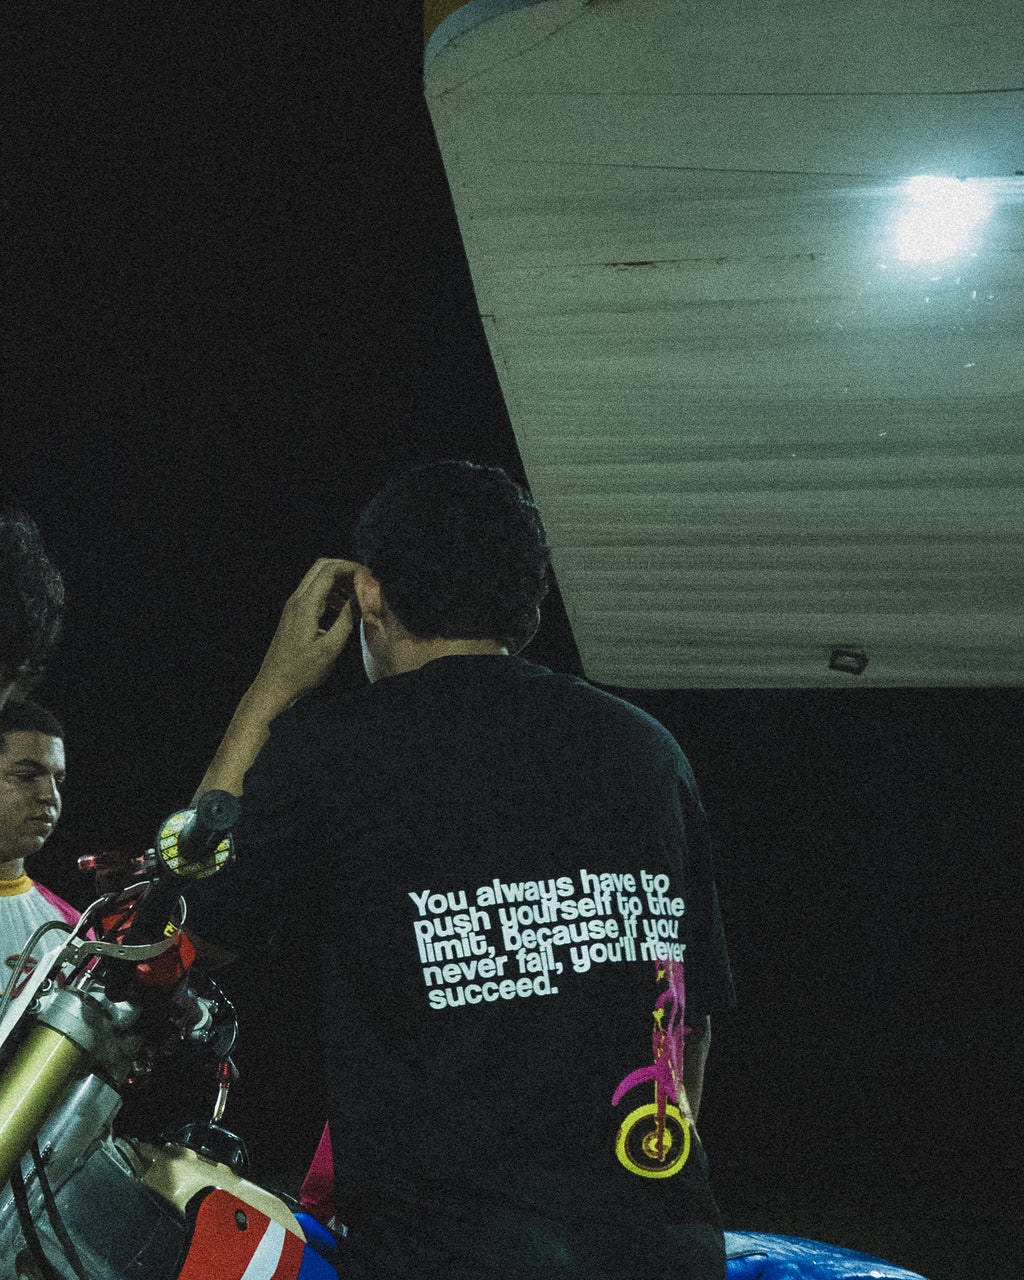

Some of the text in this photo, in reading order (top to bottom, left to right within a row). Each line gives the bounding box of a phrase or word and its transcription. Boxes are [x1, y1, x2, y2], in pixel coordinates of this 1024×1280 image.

[408, 869, 670, 916] You always have to
[413, 889, 685, 943] push yourself to the
[415, 914, 679, 964] limit, because if you
[422, 936, 686, 987] never fail, you'll never
[428, 970, 559, 1010] succeed.
